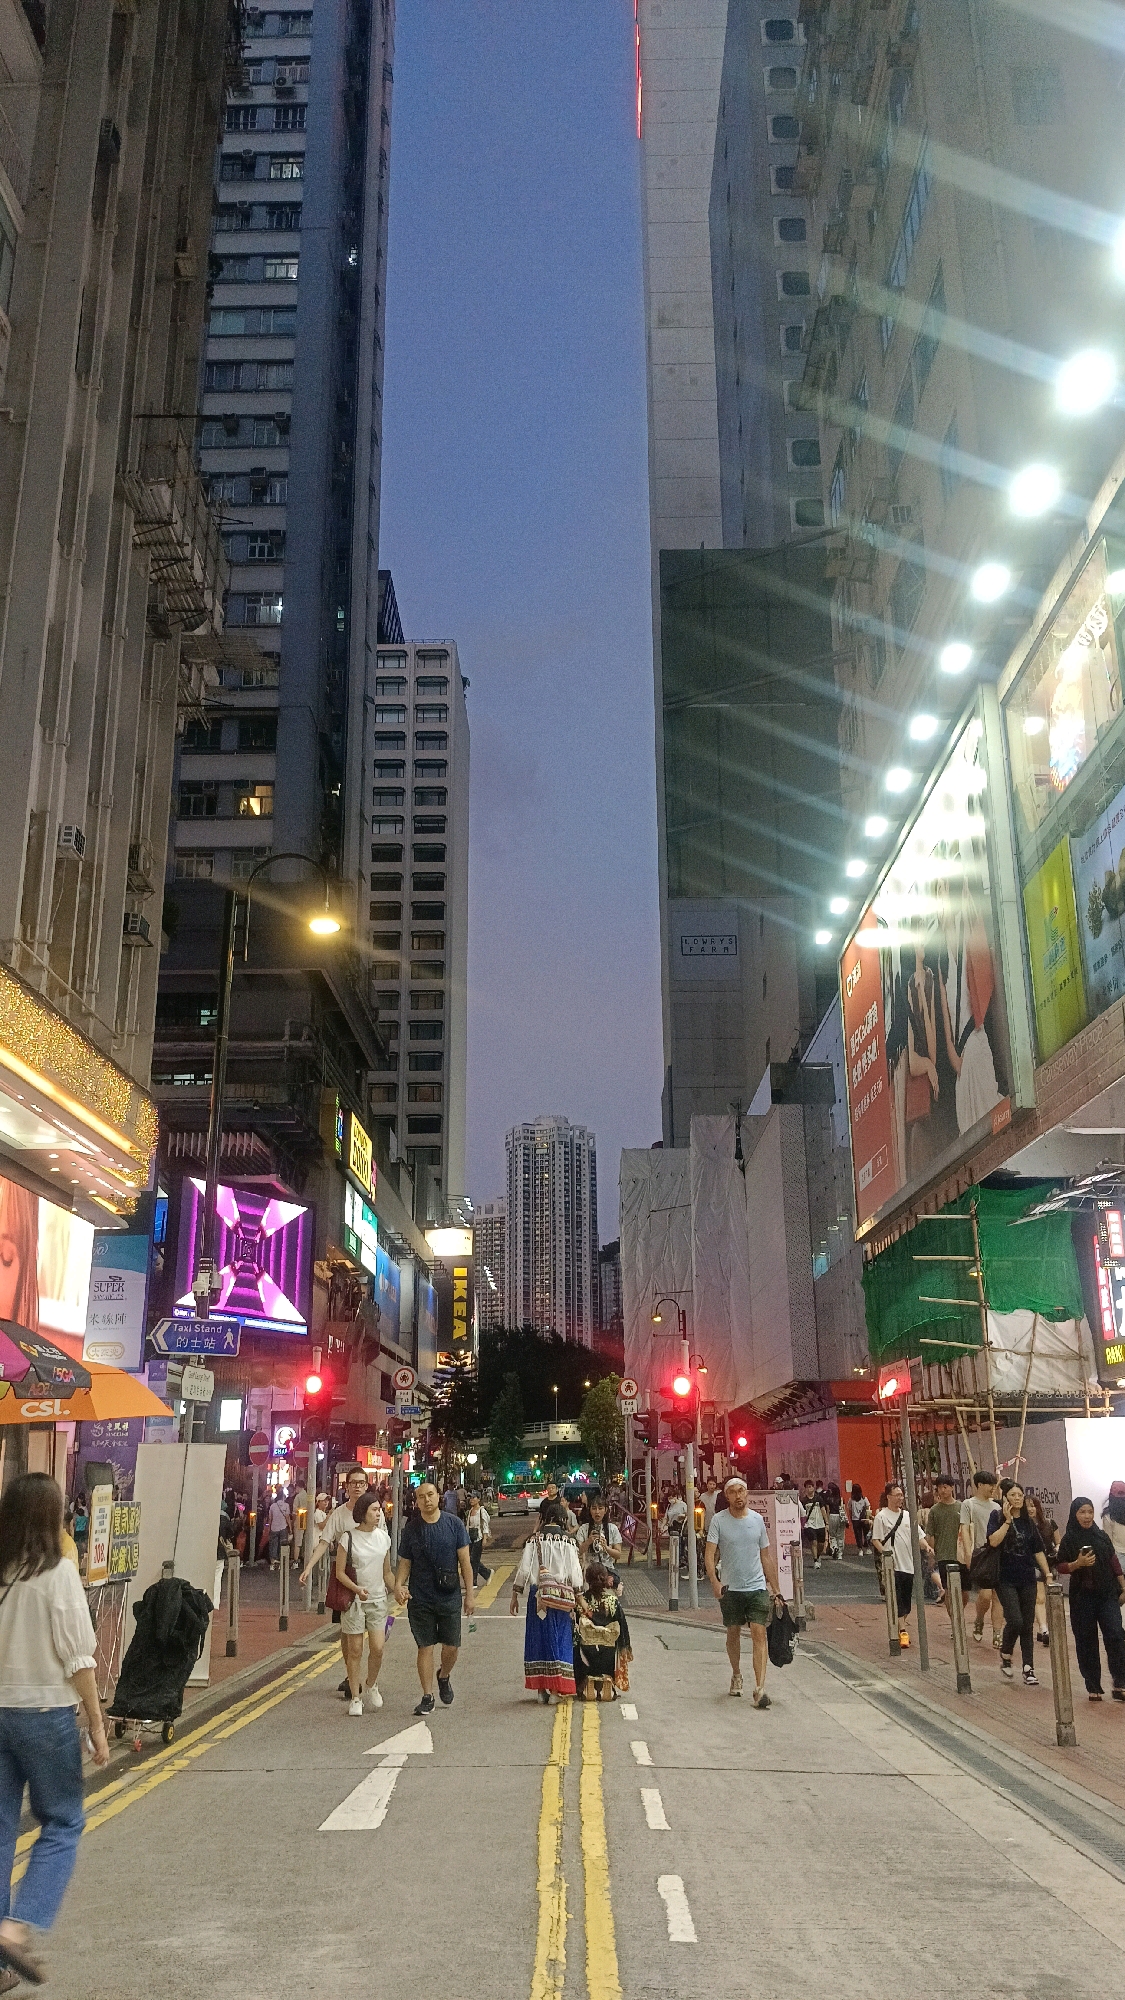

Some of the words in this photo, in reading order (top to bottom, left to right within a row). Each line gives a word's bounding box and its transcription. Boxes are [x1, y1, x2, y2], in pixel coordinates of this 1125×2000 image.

[1040, 1044, 1078, 1086] Causeway
[1078, 1025, 1103, 1051] Place
[93, 1282, 125, 1293] SUPER
[452, 1267, 468, 1340] IKEA
[173, 1323, 191, 1333] Taxi
[194, 1325, 223, 1334] Stand
[176, 1336, 216, 1350] 的士站
